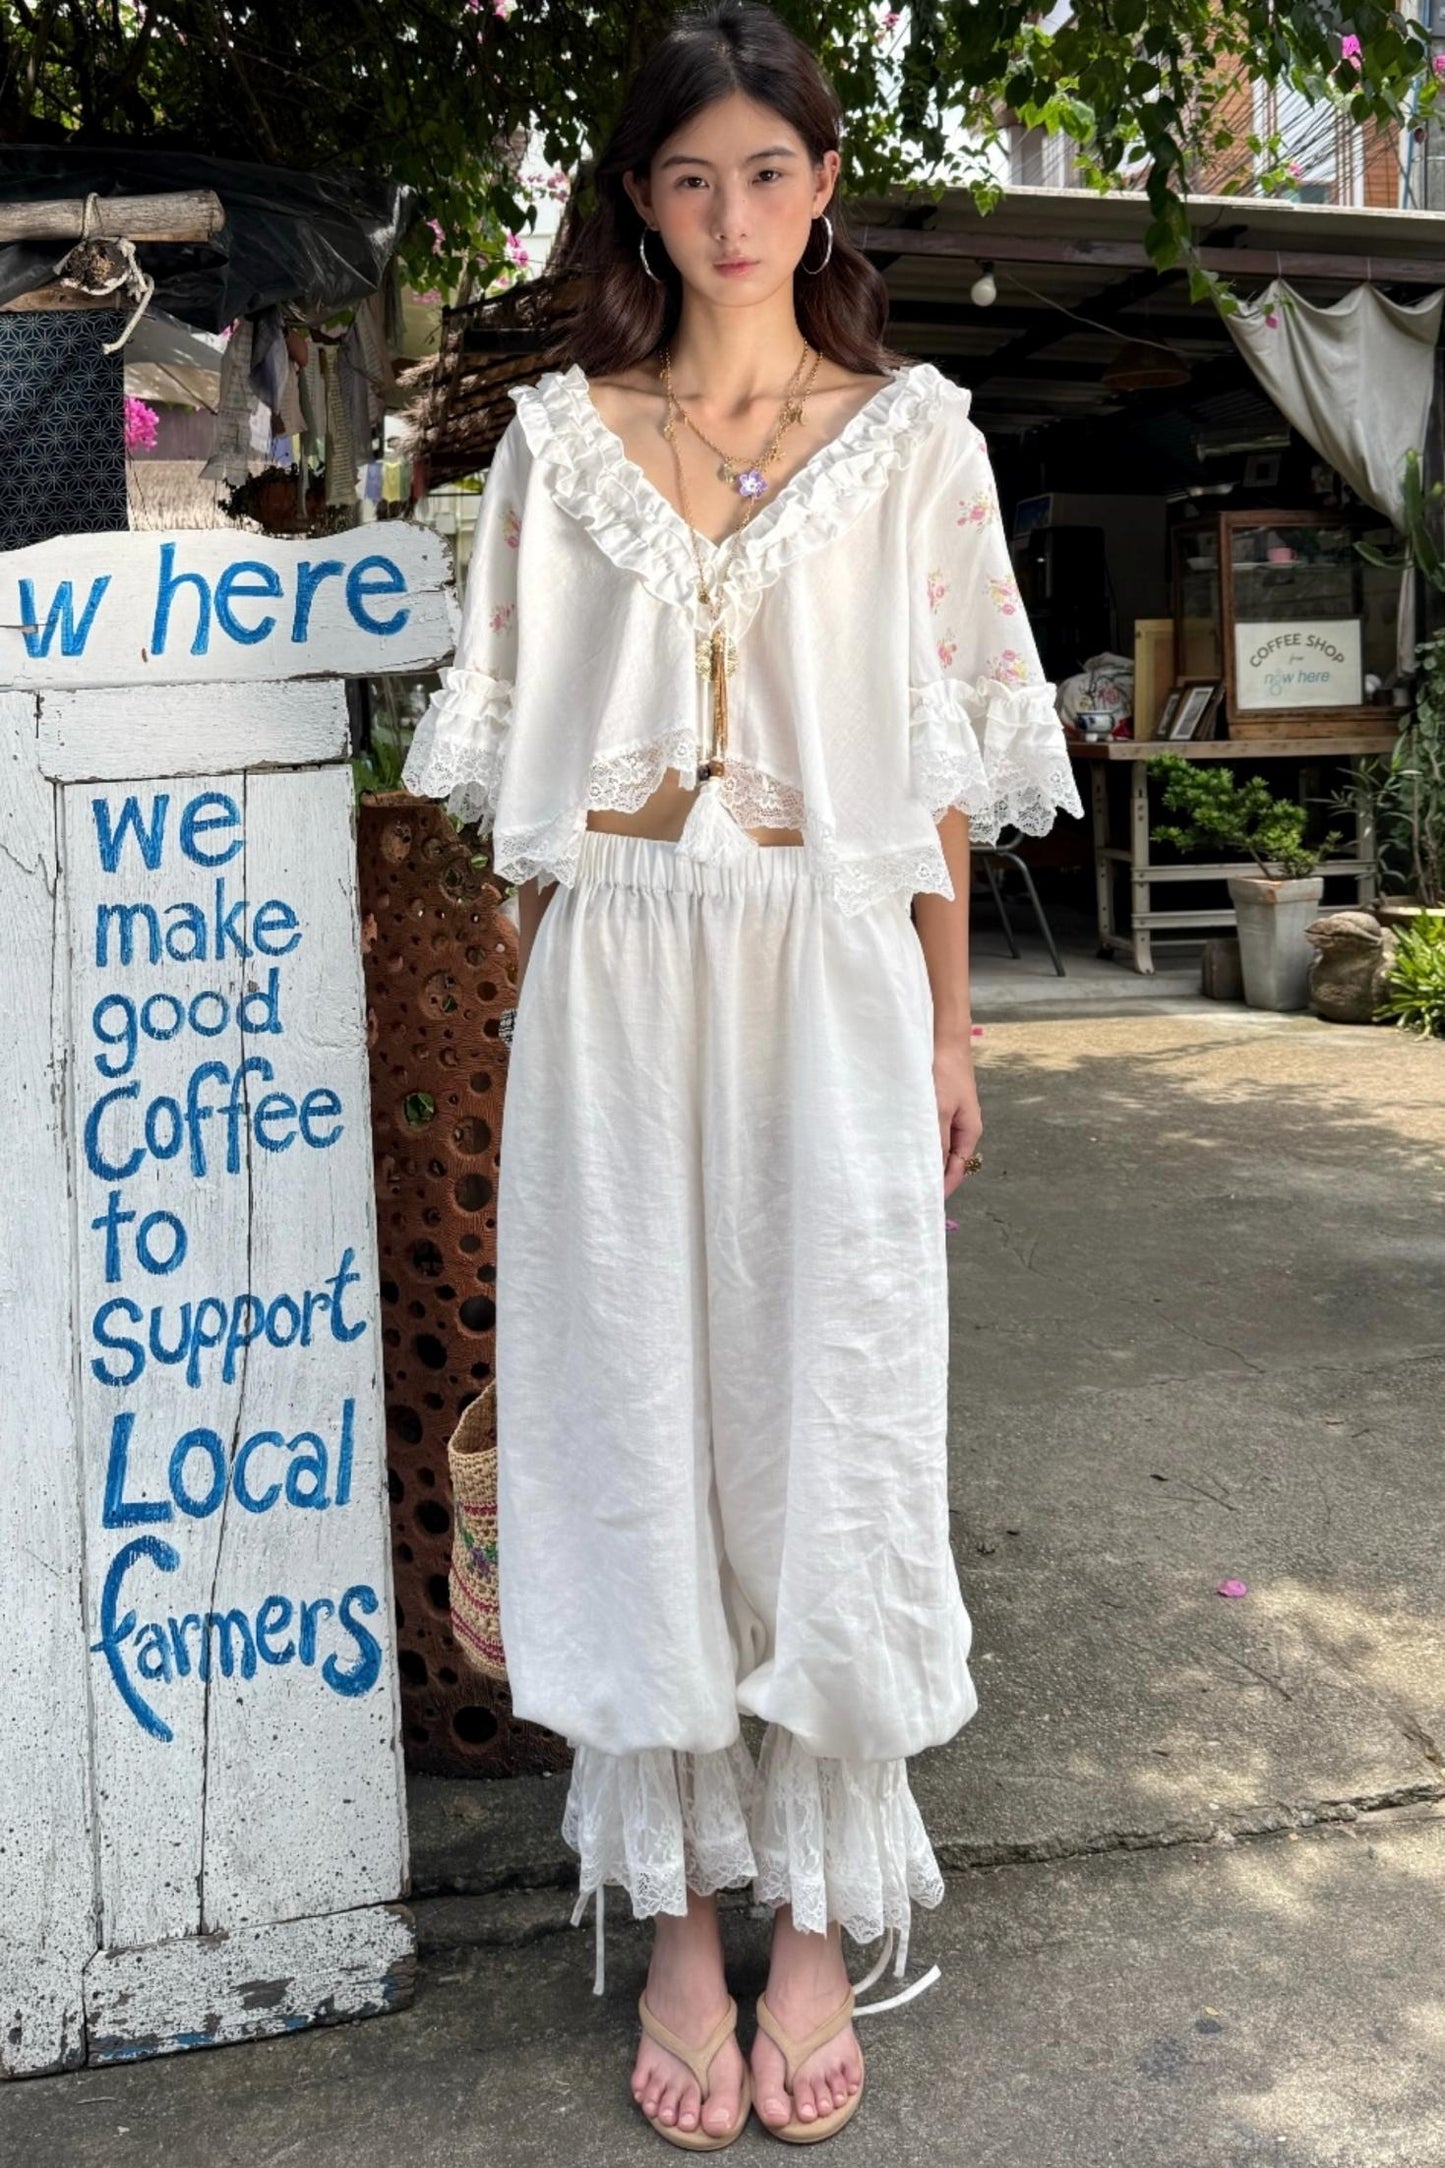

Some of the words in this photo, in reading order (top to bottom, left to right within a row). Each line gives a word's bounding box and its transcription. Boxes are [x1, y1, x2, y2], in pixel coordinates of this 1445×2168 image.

[18, 575, 112, 659] w
[150, 541, 411, 658] here
[1249, 633, 1302, 668] COFFEE
[1306, 634, 1345, 664] SHOP
[1297, 669, 1331, 684] here
[95, 877, 302, 968] make
[92, 967, 284, 1078] good
[91, 1190, 189, 1284] to
[102, 1397, 356, 1530] Local
